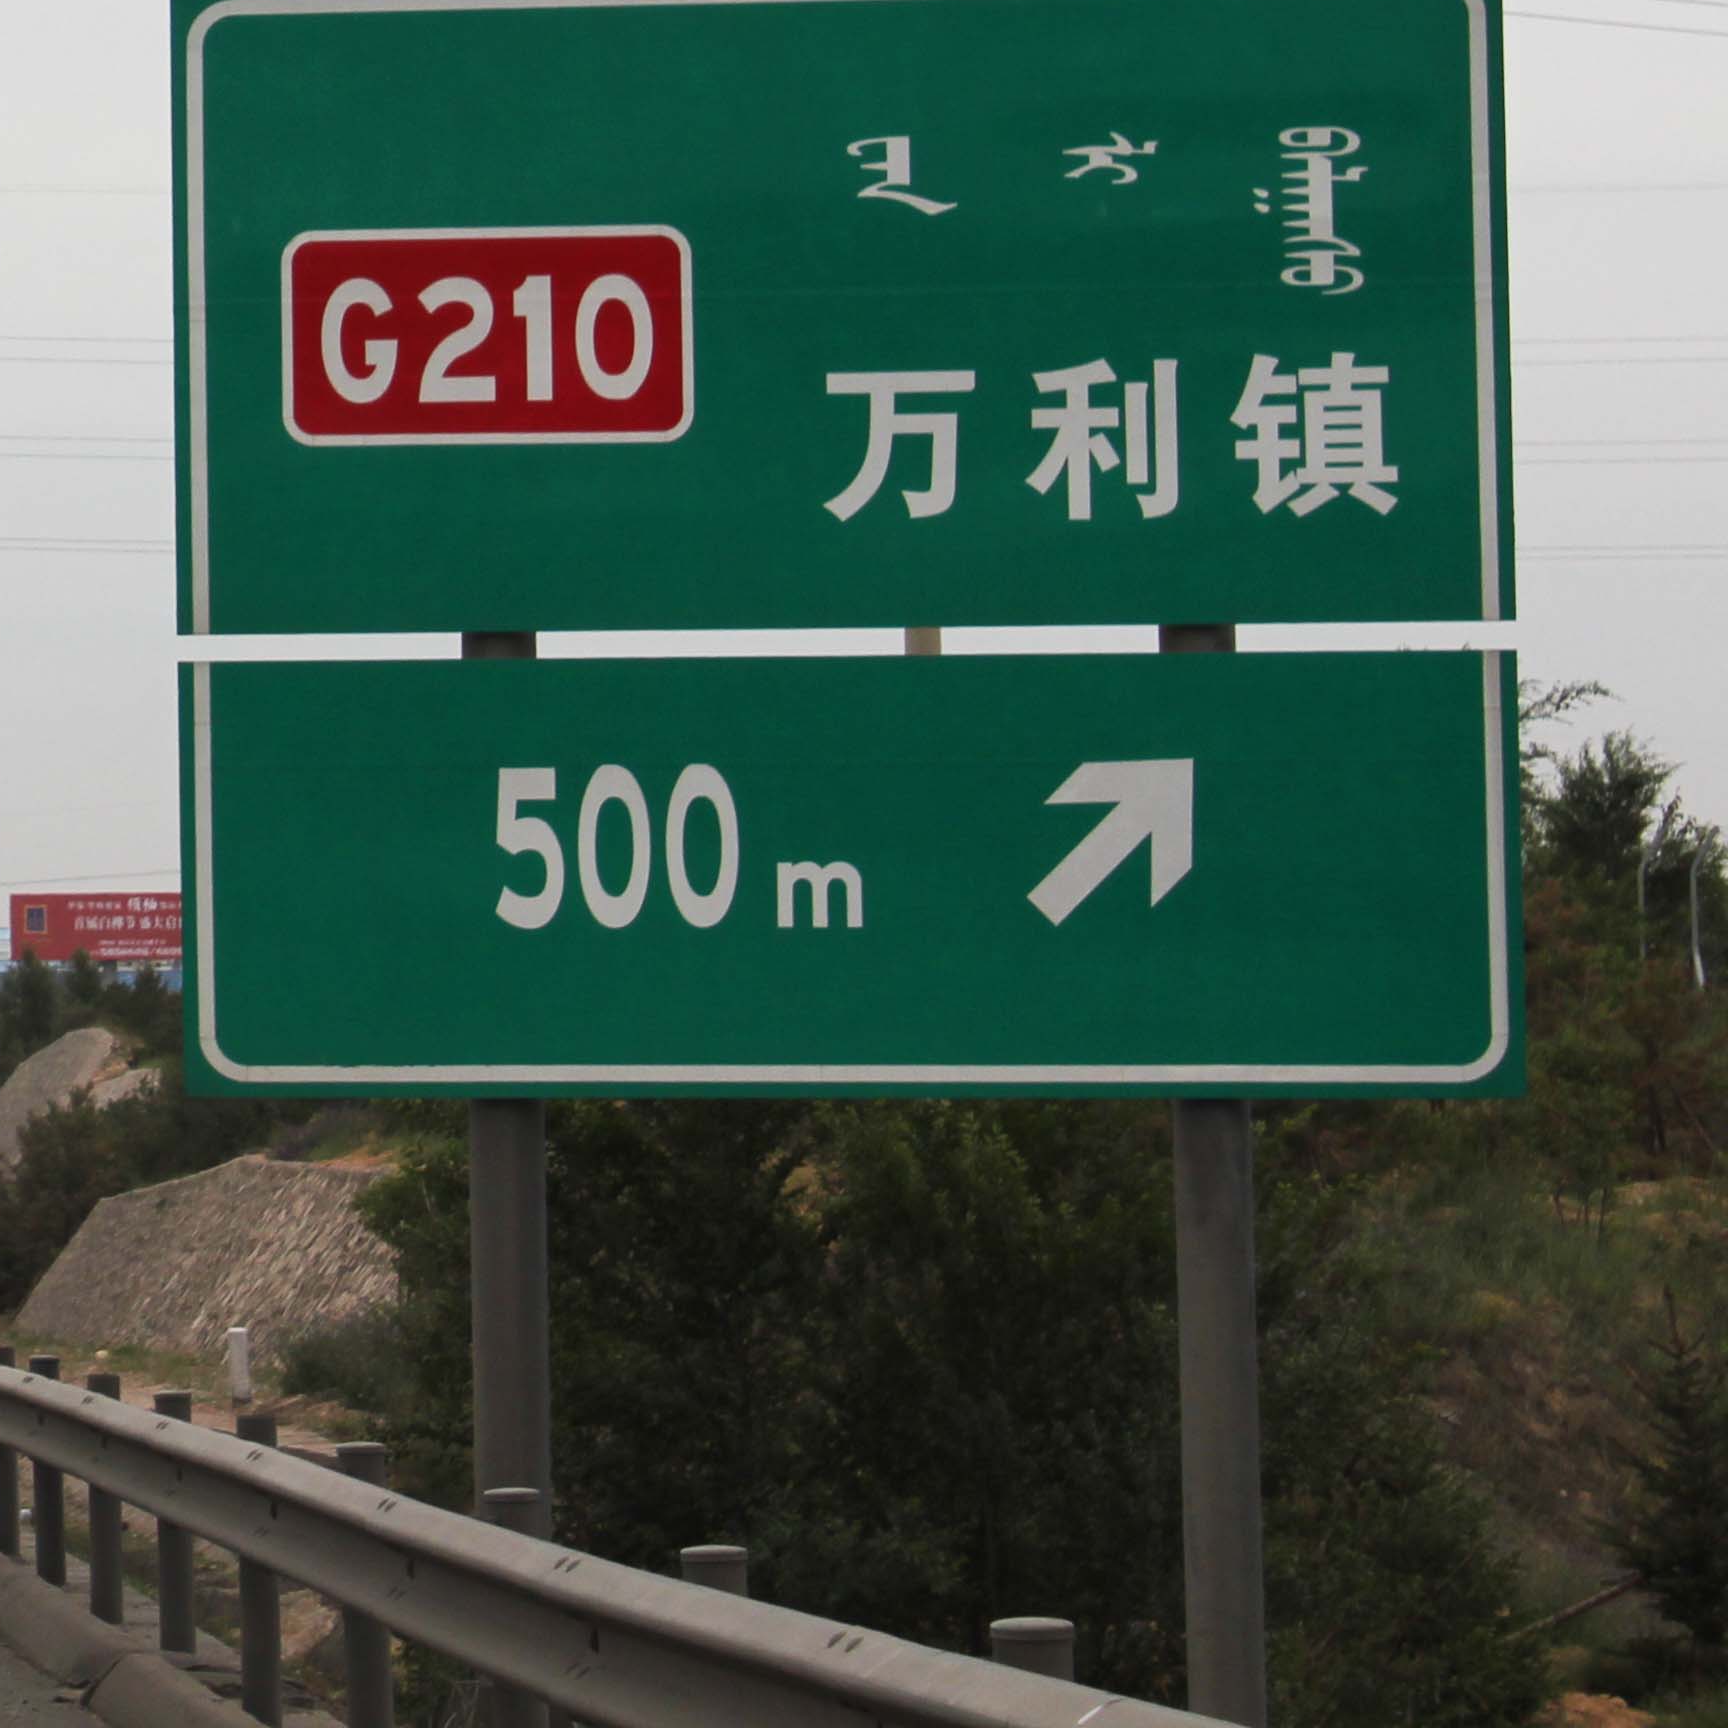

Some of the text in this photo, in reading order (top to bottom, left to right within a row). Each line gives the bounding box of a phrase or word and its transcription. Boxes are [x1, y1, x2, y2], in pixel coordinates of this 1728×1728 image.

[320, 272, 654, 405] G210
[823, 351, 1399, 522] 万利镇
[495, 763, 864, 930] 500 m
